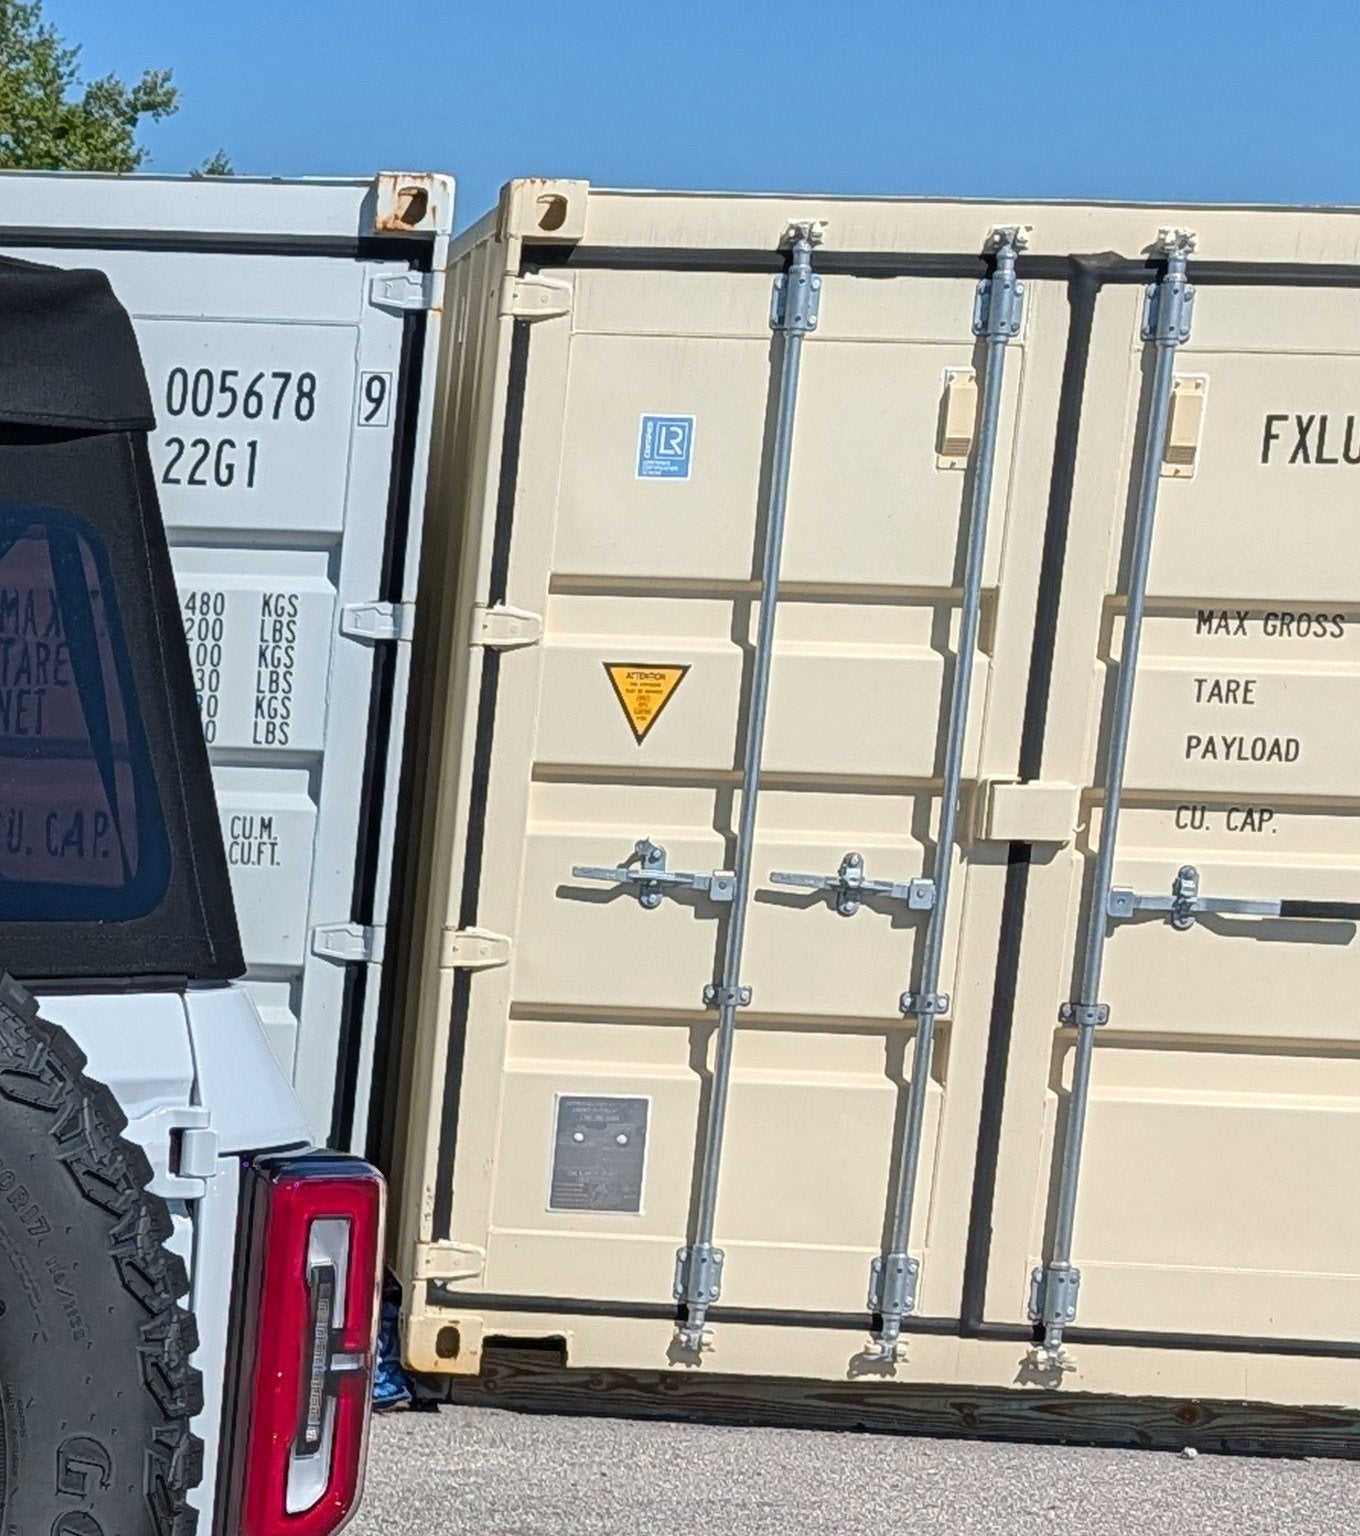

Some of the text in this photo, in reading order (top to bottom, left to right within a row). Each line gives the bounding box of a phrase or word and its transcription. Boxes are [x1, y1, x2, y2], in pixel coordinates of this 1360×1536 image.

[166, 367, 386, 423] 005678 9
[1261, 414, 1360, 465] FXLU
[162, 437, 258, 488] 22G1
[261, 593, 299, 618] KGS
[259, 619, 297, 644] LBS
[1196, 610, 1346, 638] MAX GROSS
[257, 644, 295, 669] KGS
[255, 670, 293, 694] LBS
[1194, 678, 1257, 704] TARE
[254, 695, 292, 720] KGS
[252, 720, 290, 745] LBS
[1185, 735, 1300, 762] PAYLOAD
[1175, 805, 1277, 833] CU. CAP.
